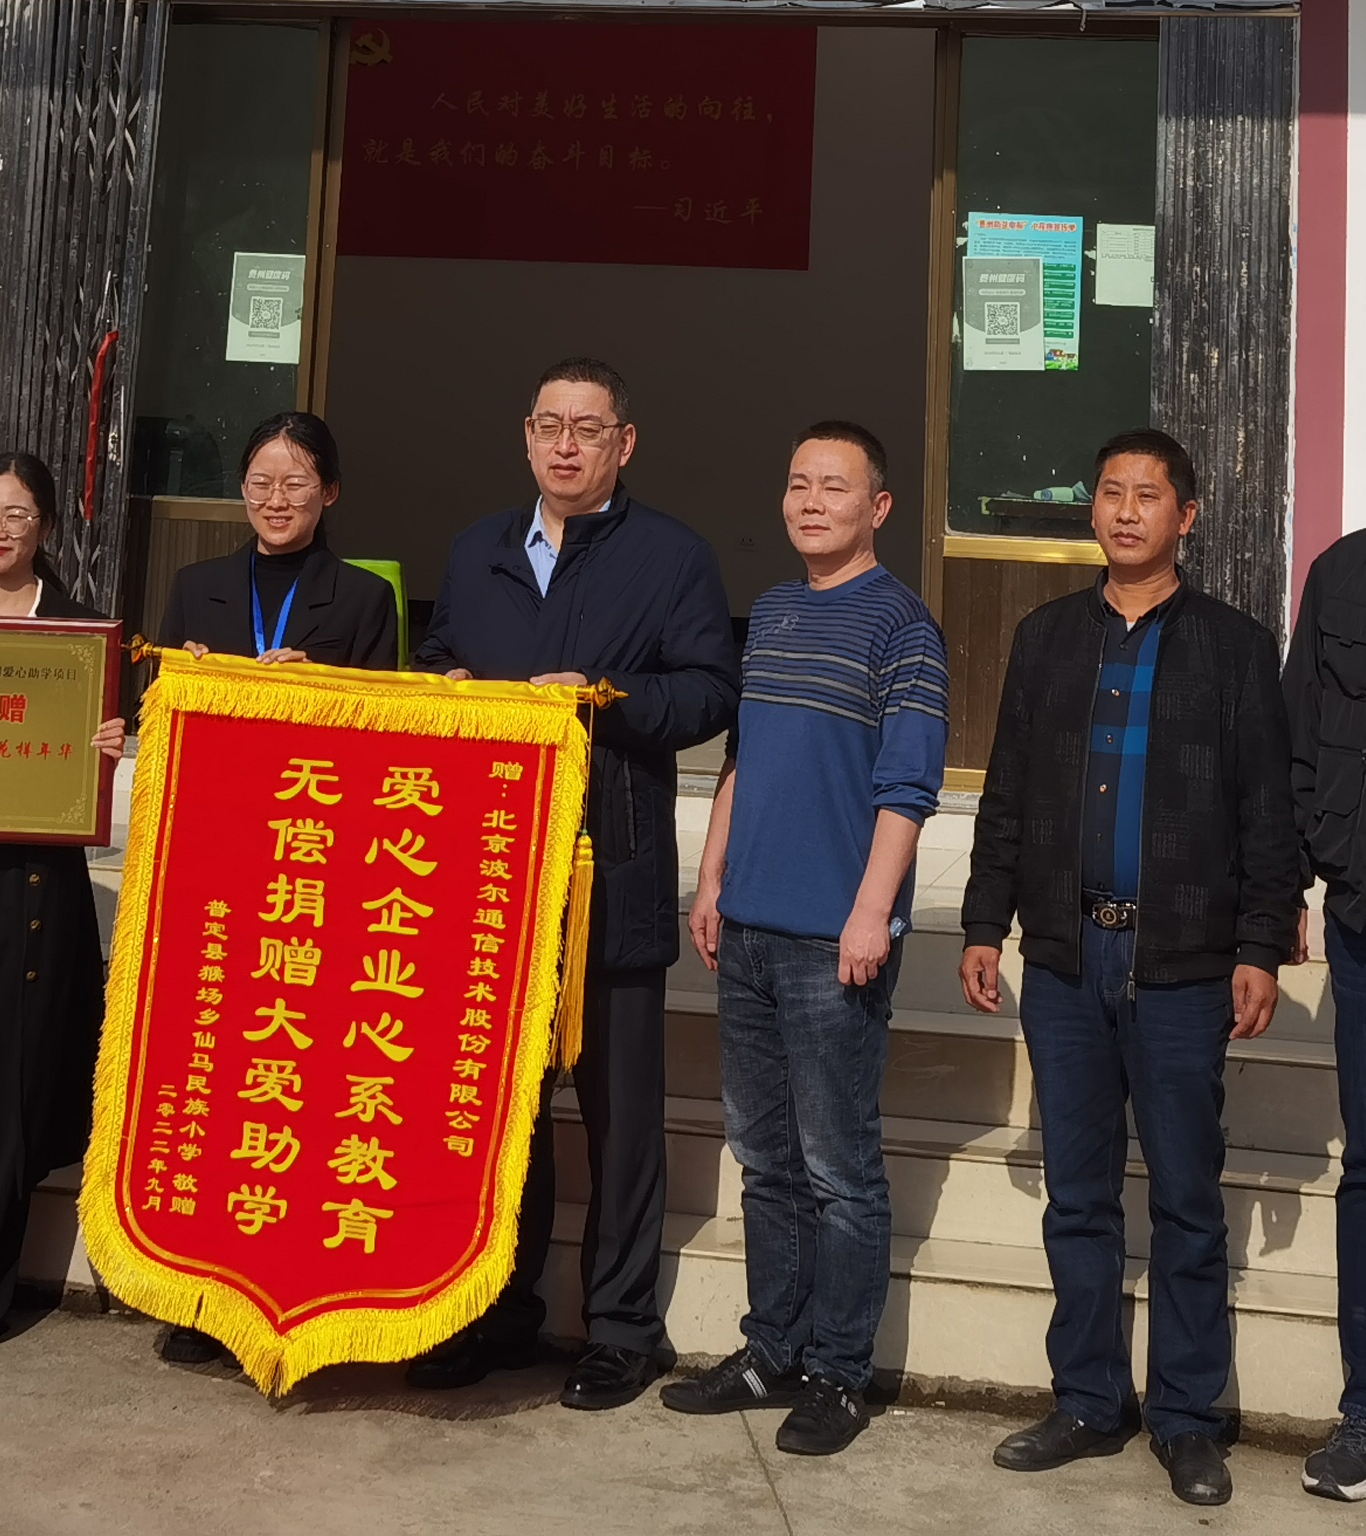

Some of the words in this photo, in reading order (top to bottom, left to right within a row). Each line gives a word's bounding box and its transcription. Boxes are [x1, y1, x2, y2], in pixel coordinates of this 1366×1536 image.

[141, 1084, 178, 1212] 二零二二年九月
[227, 757, 343, 1236] 无偿捐赠大爱助学
[322, 766, 443, 1254] 爱心企业心系教育
